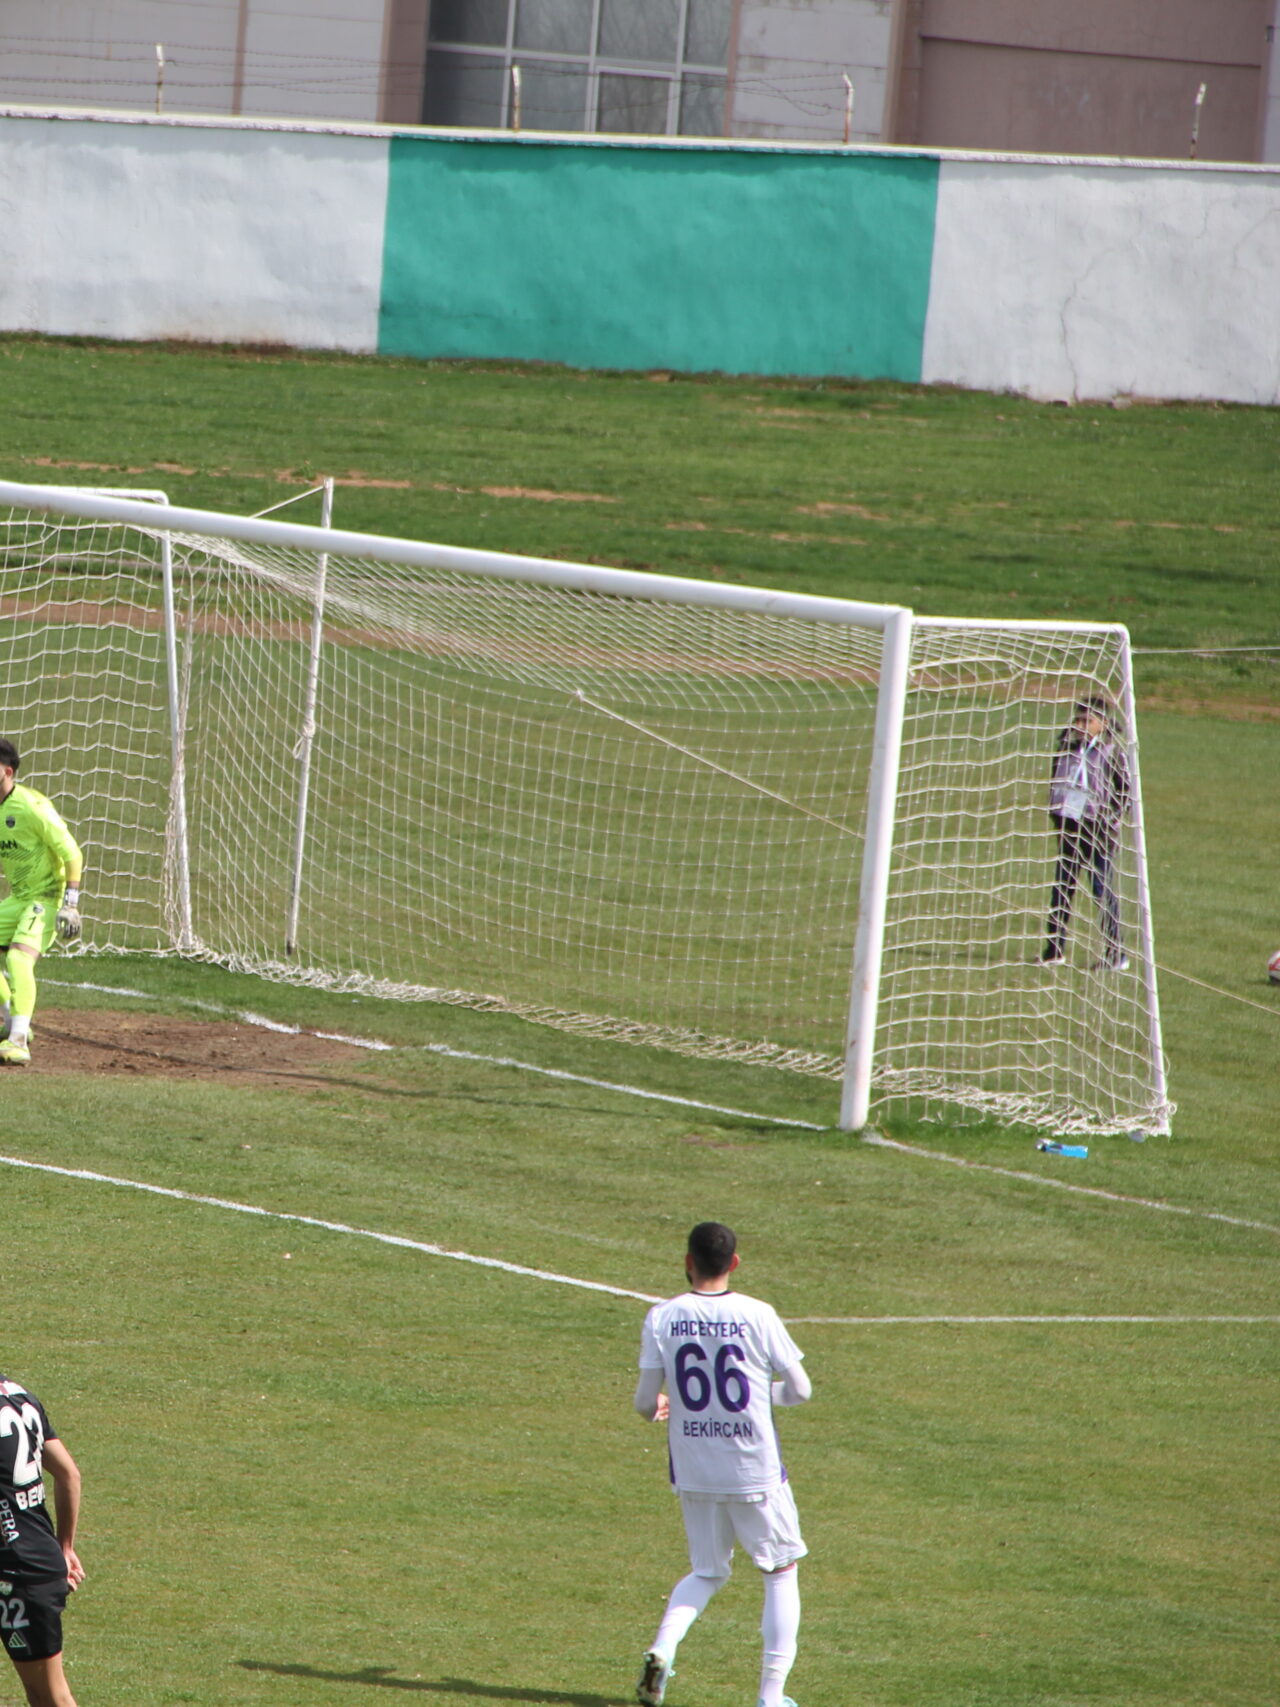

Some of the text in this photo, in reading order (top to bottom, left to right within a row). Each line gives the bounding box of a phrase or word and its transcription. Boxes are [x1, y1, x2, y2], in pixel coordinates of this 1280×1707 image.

[671, 1320, 747, 1338] HACETTEPE
[675, 1342, 750, 1413] 66
[683, 1418, 753, 1438] BEKİRCAN
